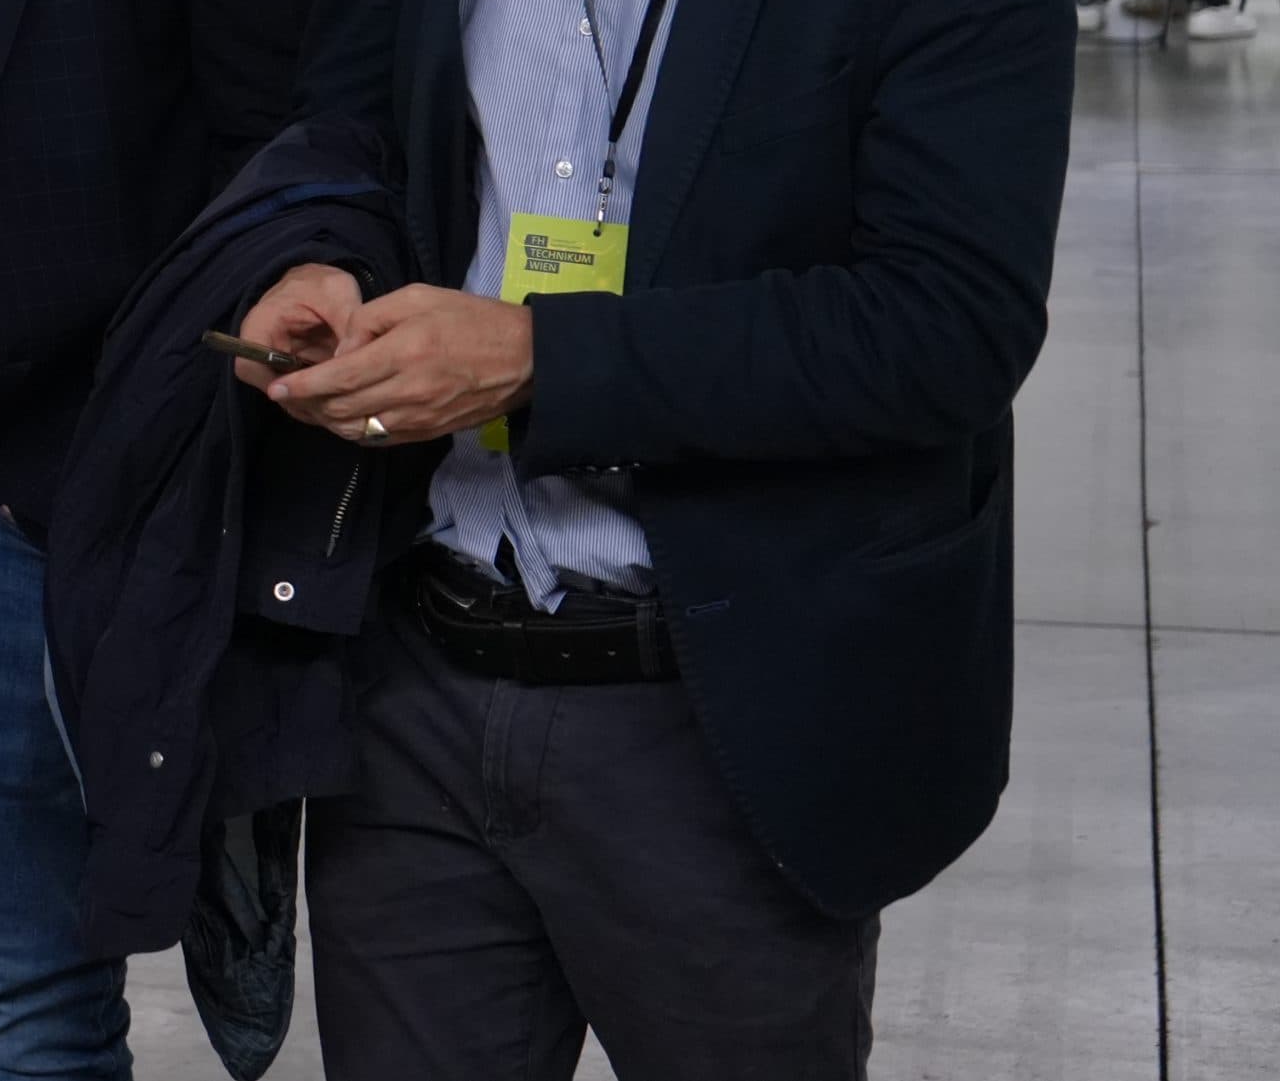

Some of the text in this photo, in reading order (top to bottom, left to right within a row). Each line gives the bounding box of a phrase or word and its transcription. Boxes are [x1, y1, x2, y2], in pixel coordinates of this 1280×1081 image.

[531, 236, 545, 246] FH
[531, 248, 592, 265] TECHNIKUM
[529, 260, 558, 273] WIEN
